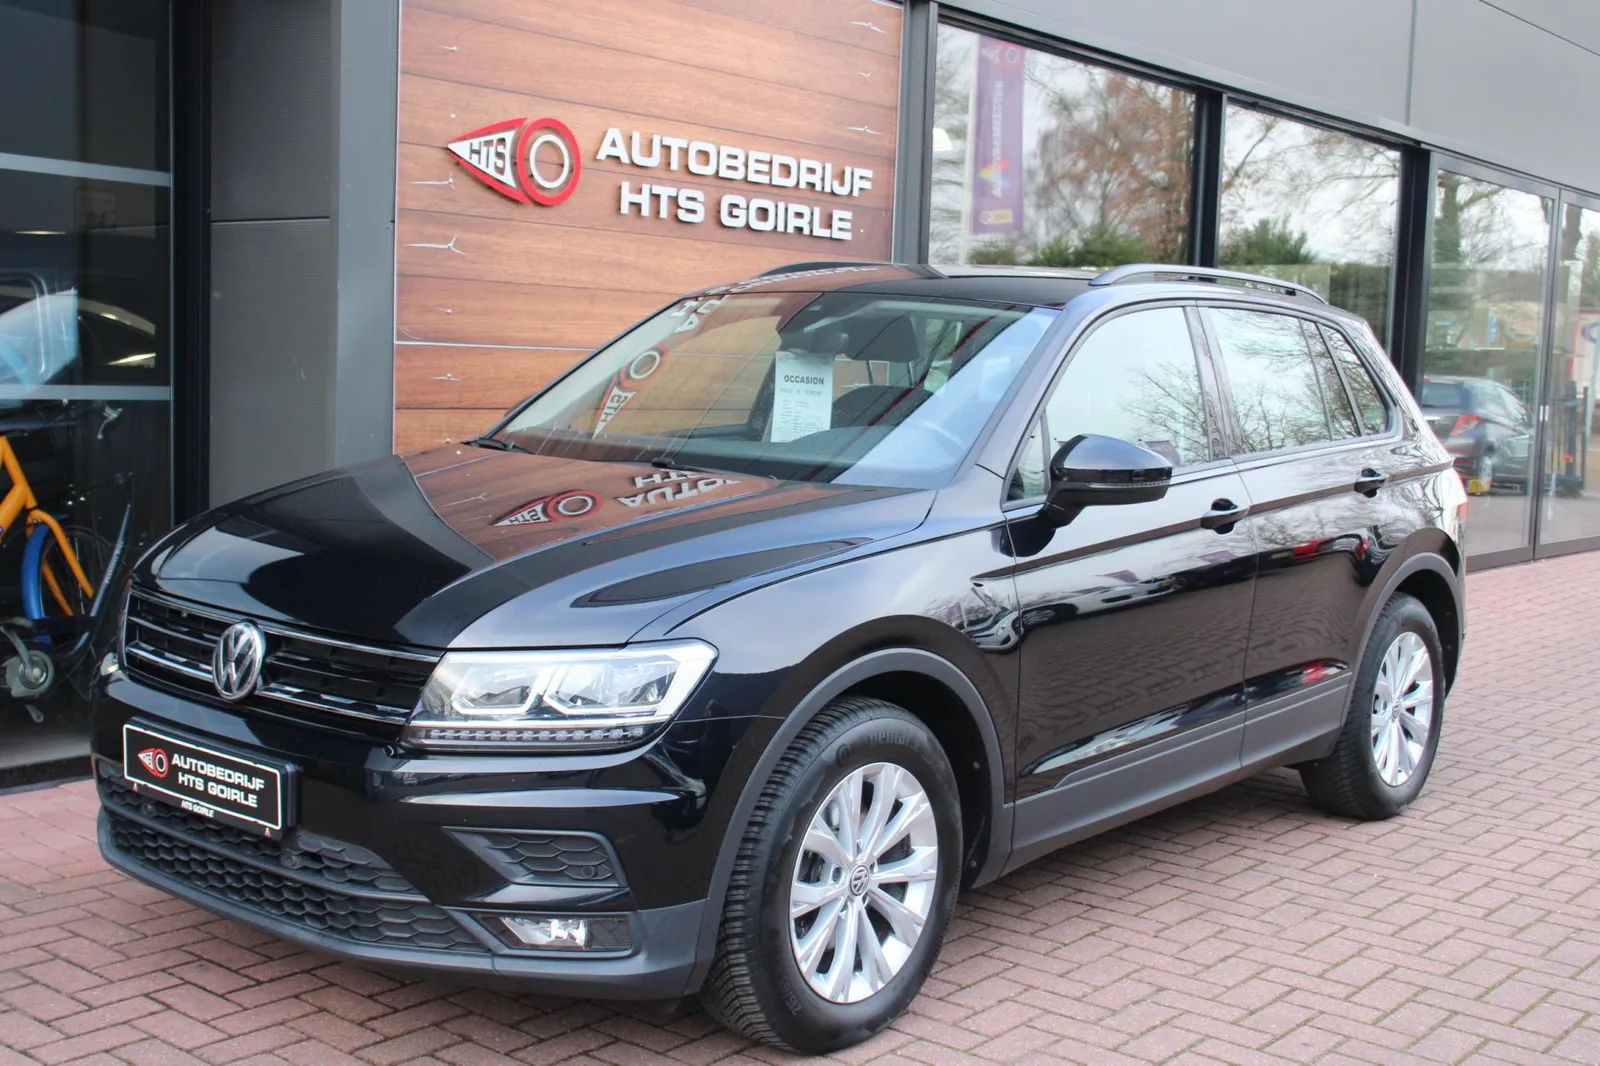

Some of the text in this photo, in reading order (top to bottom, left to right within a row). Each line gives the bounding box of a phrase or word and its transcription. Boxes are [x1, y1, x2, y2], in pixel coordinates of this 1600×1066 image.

[468, 137, 507, 177] HTS
[596, 127, 873, 197] AUTOBEDRIJF
[620, 181, 853, 240] HTS GOIRLE
[783, 374, 825, 385] OCCASION
[171, 753, 265, 791] AUTOBEDRIJF
[178, 772, 258, 808] HTS GOIRLE
[181, 799, 214, 818] HTS GOIRLE
